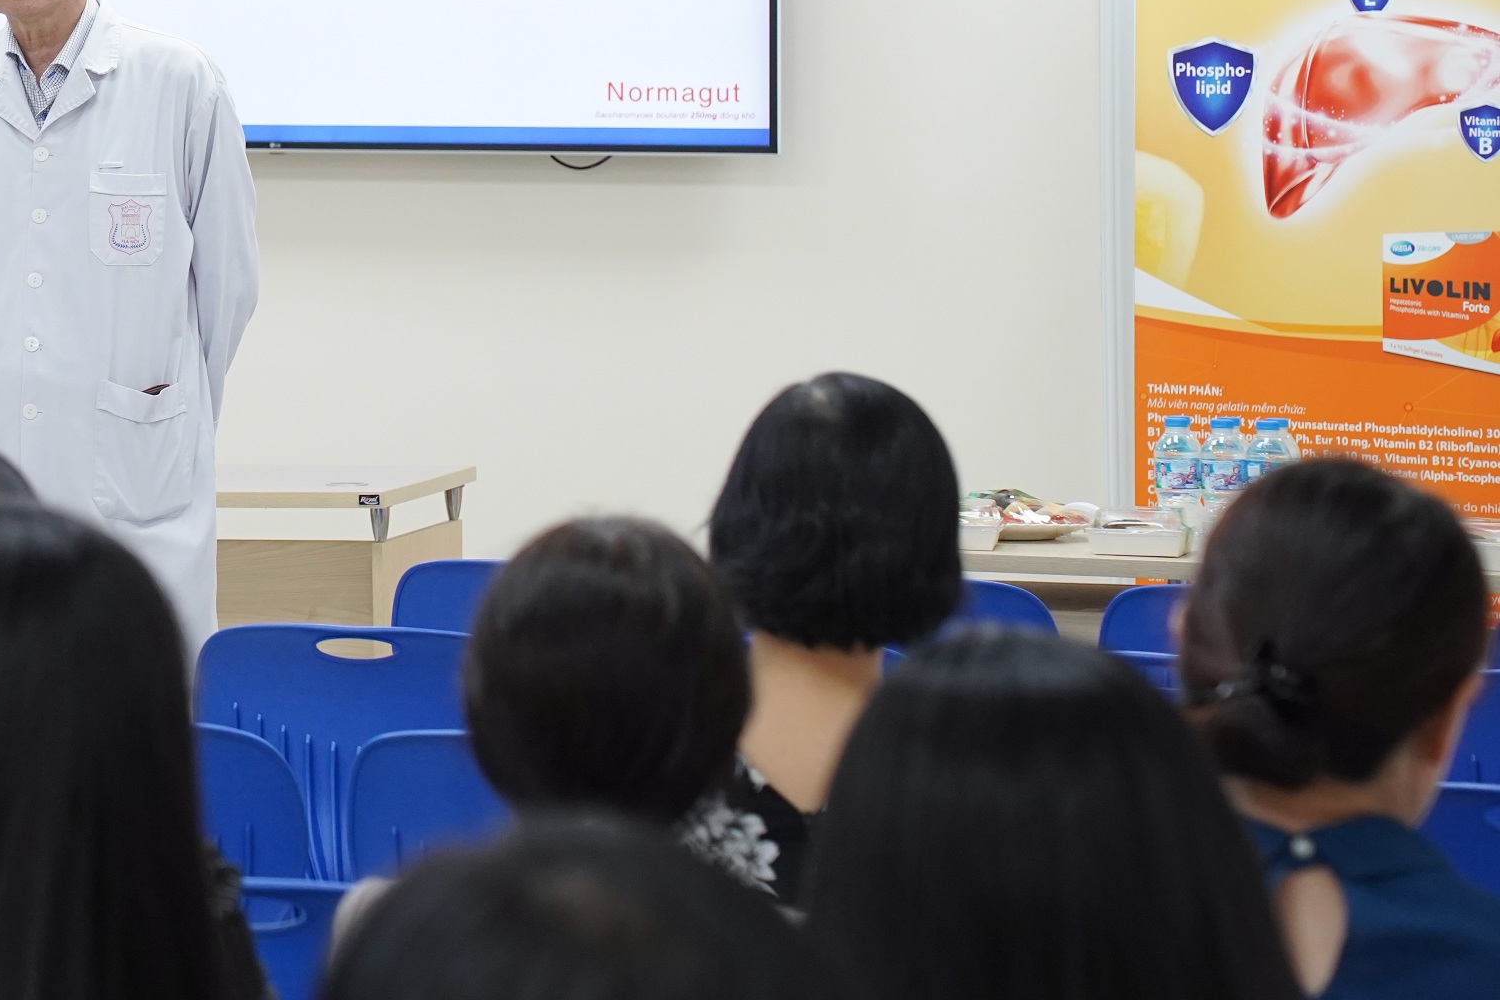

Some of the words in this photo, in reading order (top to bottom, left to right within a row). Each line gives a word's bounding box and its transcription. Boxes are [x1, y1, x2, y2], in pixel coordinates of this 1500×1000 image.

[1175, 62, 1251, 80] Phospho-
[607, 82, 740, 108] Normagut
[1195, 80, 1231, 98] lipid
[691, 111, 717, 120] 250mg
[1479, 138, 1493, 155] B
[1392, 244, 1413, 252] MEGA
[1389, 277, 1491, 301] LIVOLIN
[1389, 305, 1426, 316] Phospholipids
[1427, 308, 1440, 317] with
[1441, 310, 1470, 320] Vitamins
[1462, 301, 1490, 314] Forte
[1147, 383, 1187, 395] THÀNH
[1168, 399, 1189, 409] viên
[1190, 401, 1214, 413] nang
[1216, 401, 1250, 414] gelatin
[1278, 404, 1306, 415] chứa:
[1364, 422, 1483, 439] Phosphatidylcholine)
[1296, 434, 1312, 444] Ph.
[1315, 435, 1333, 445] Eur
[1336, 436, 1349, 446] 10
[1351, 439, 1371, 449] mg,
[1373, 438, 1416, 450] Vitamin
[1418, 440, 1433, 451] B2
[1361, 453, 1381, 464] mg,
[1384, 453, 1428, 465] Vitamin
[1432, 456, 1454, 466] B12
[360, 496, 379, 504] Royal
